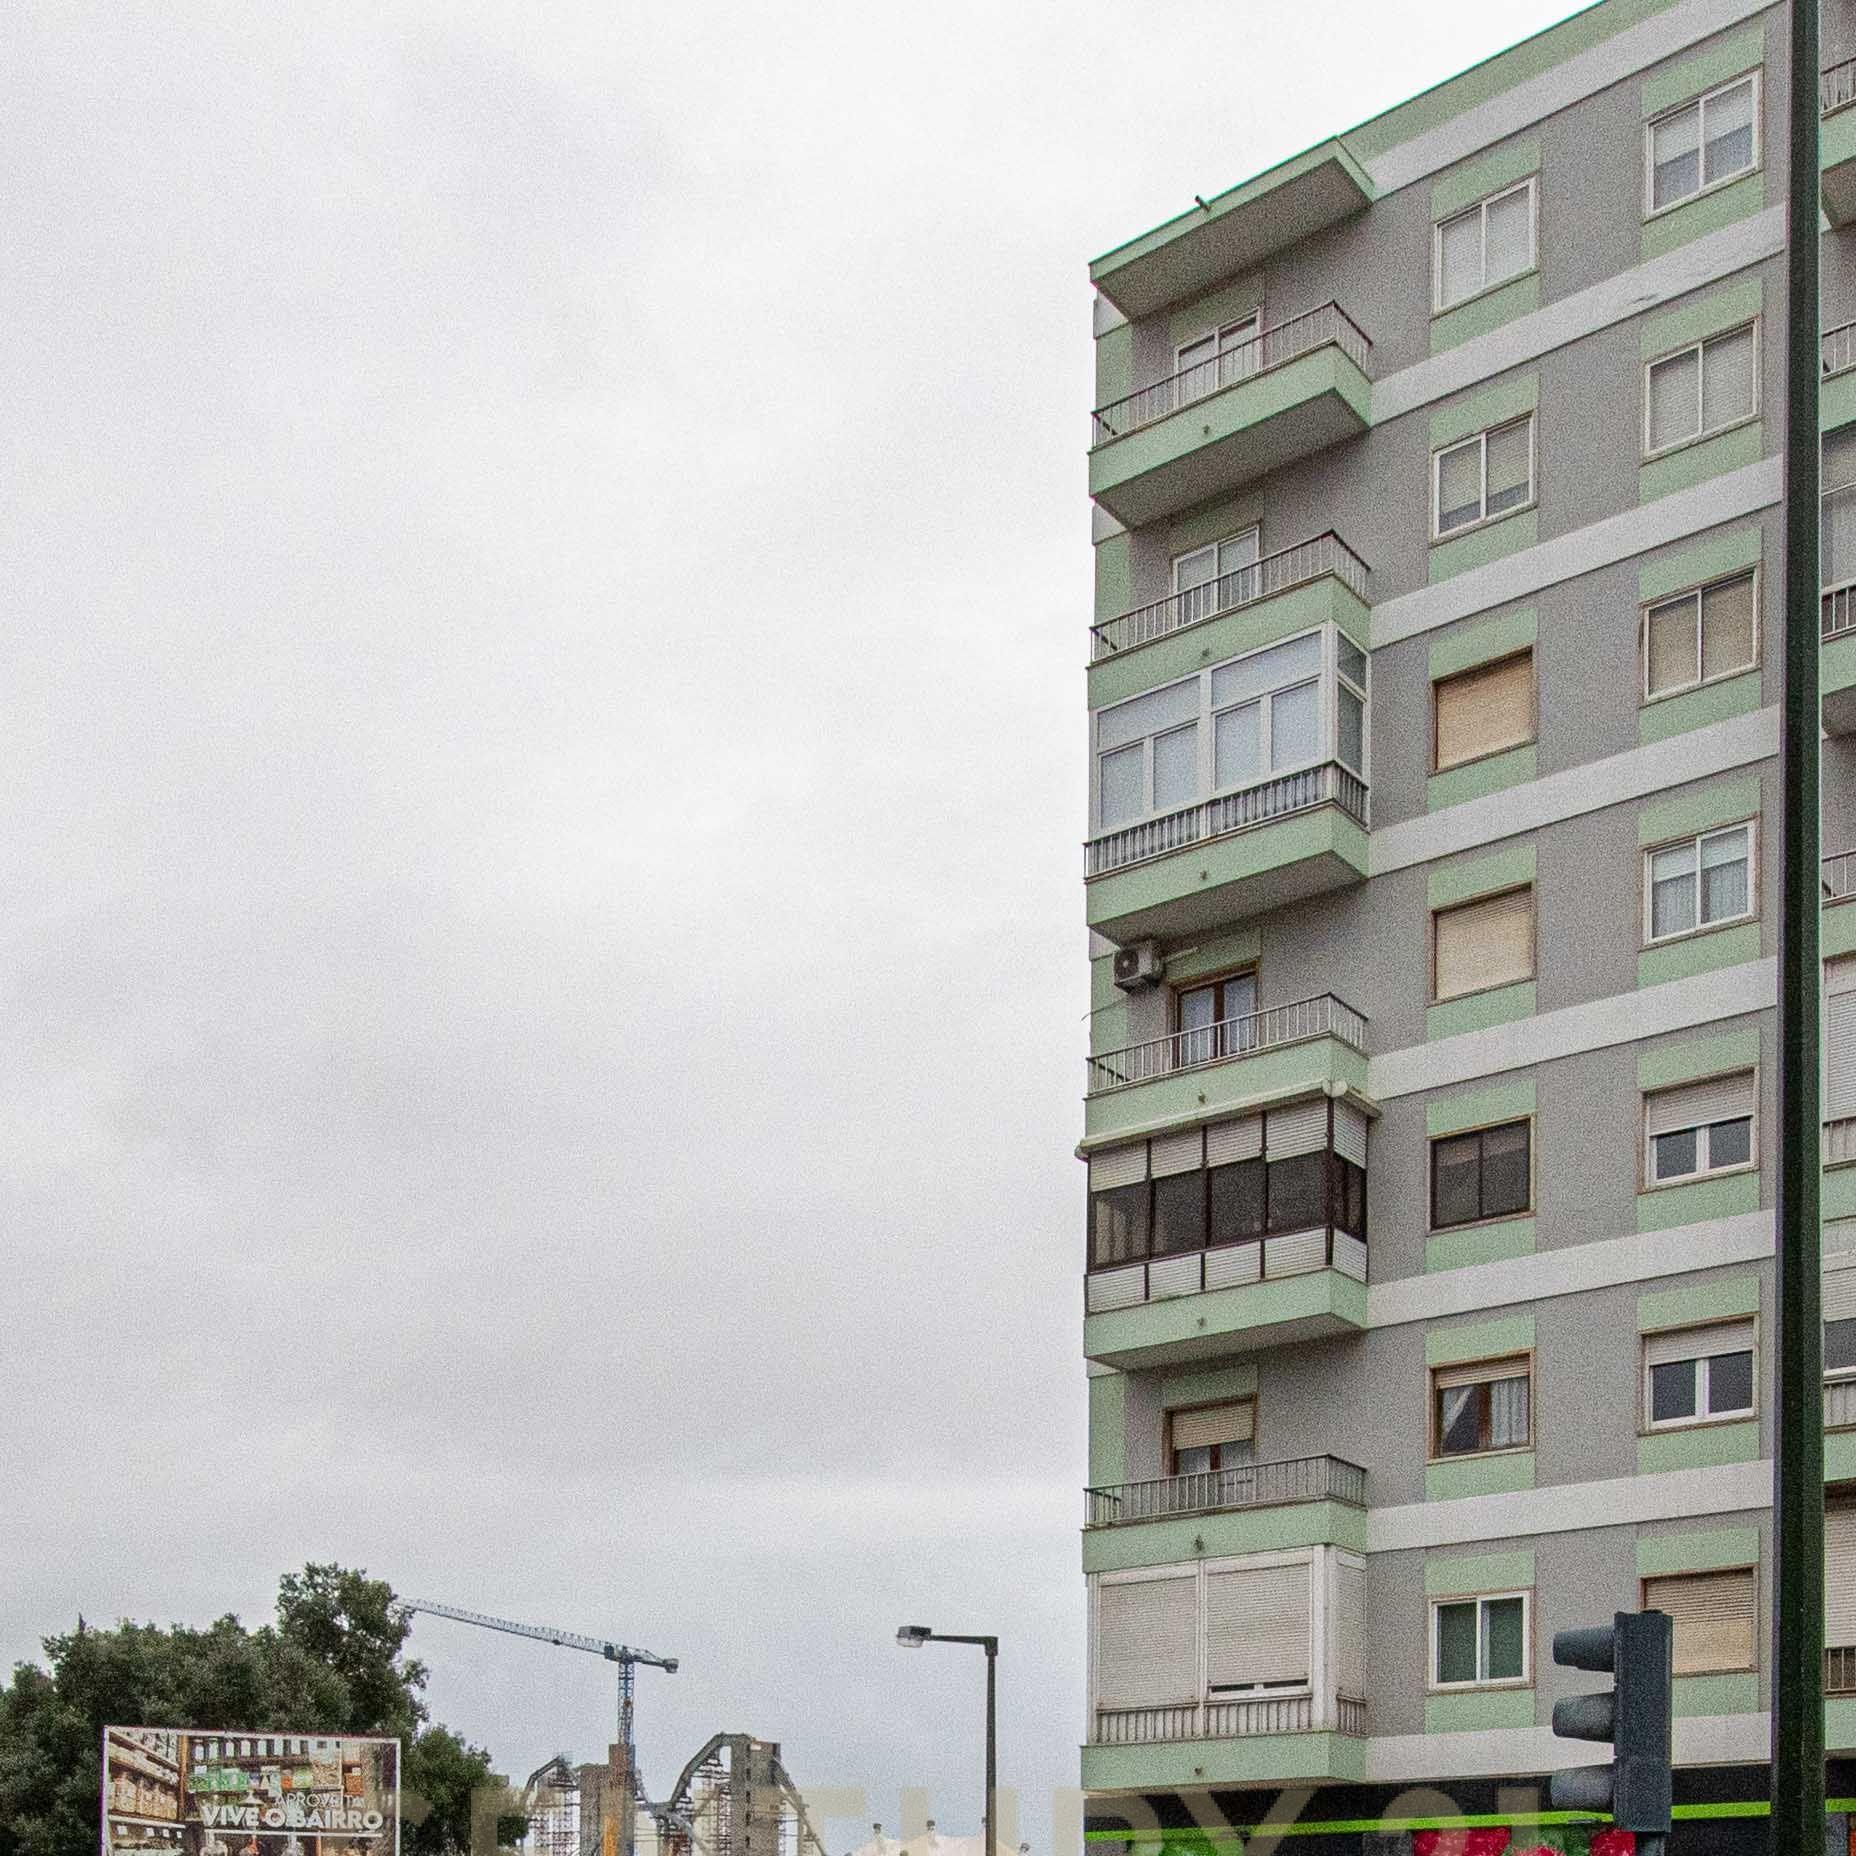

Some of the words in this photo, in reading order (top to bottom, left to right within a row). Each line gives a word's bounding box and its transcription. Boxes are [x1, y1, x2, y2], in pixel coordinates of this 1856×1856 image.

[203, 1805, 260, 1827] VIVE
[264, 1808, 286, 1828] O
[292, 1808, 384, 1830] BAIRRO
